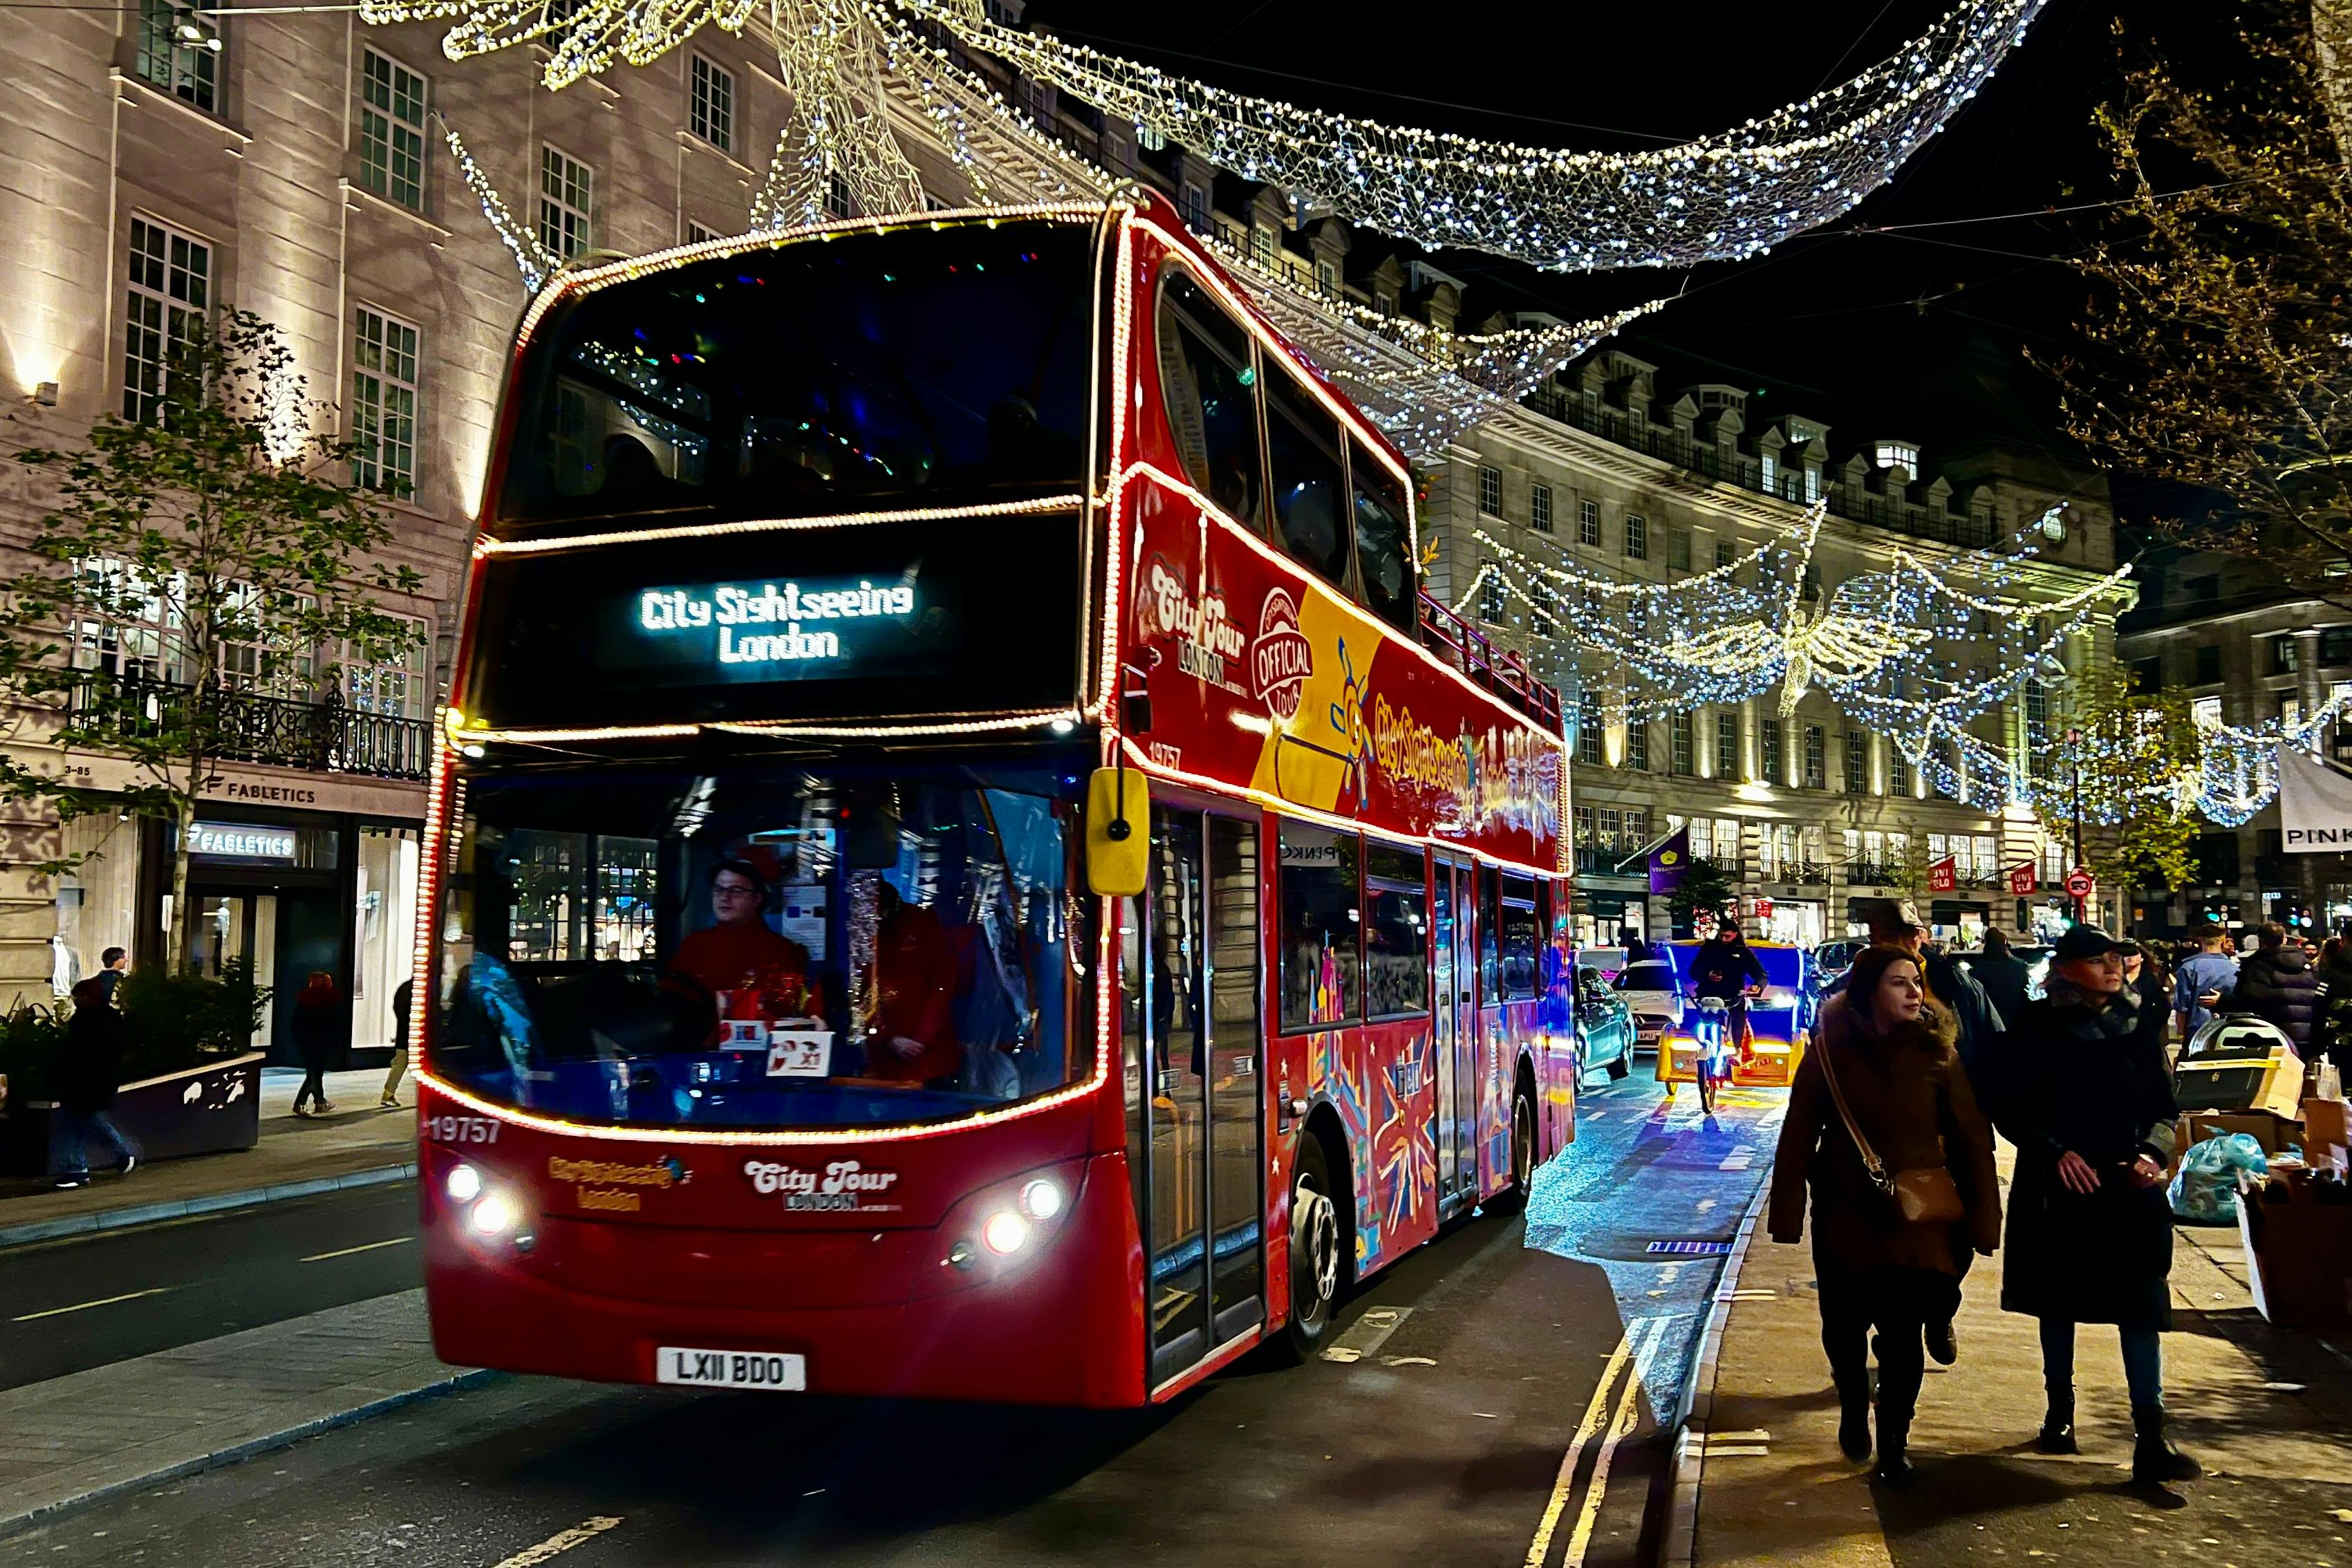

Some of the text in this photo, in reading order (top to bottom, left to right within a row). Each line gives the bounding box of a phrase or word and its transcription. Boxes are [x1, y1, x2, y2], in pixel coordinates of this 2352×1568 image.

[641, 581, 914, 629] City Sightseeing
[1152, 564, 1200, 645] City
[1205, 597, 1245, 657] Tour
[719, 622, 838, 663] London
[1258, 640, 1311, 687] OFFICIAL
[1276, 684, 1300, 716] TOUR
[1149, 740, 1181, 770] 19757
[228, 783, 315, 803] FABLETICS
[200, 832, 293, 856] FABLETICS
[429, 1116, 502, 1144] 19757
[744, 1160, 897, 1194] City Tour
[731, 1356, 784, 1384] BDO
